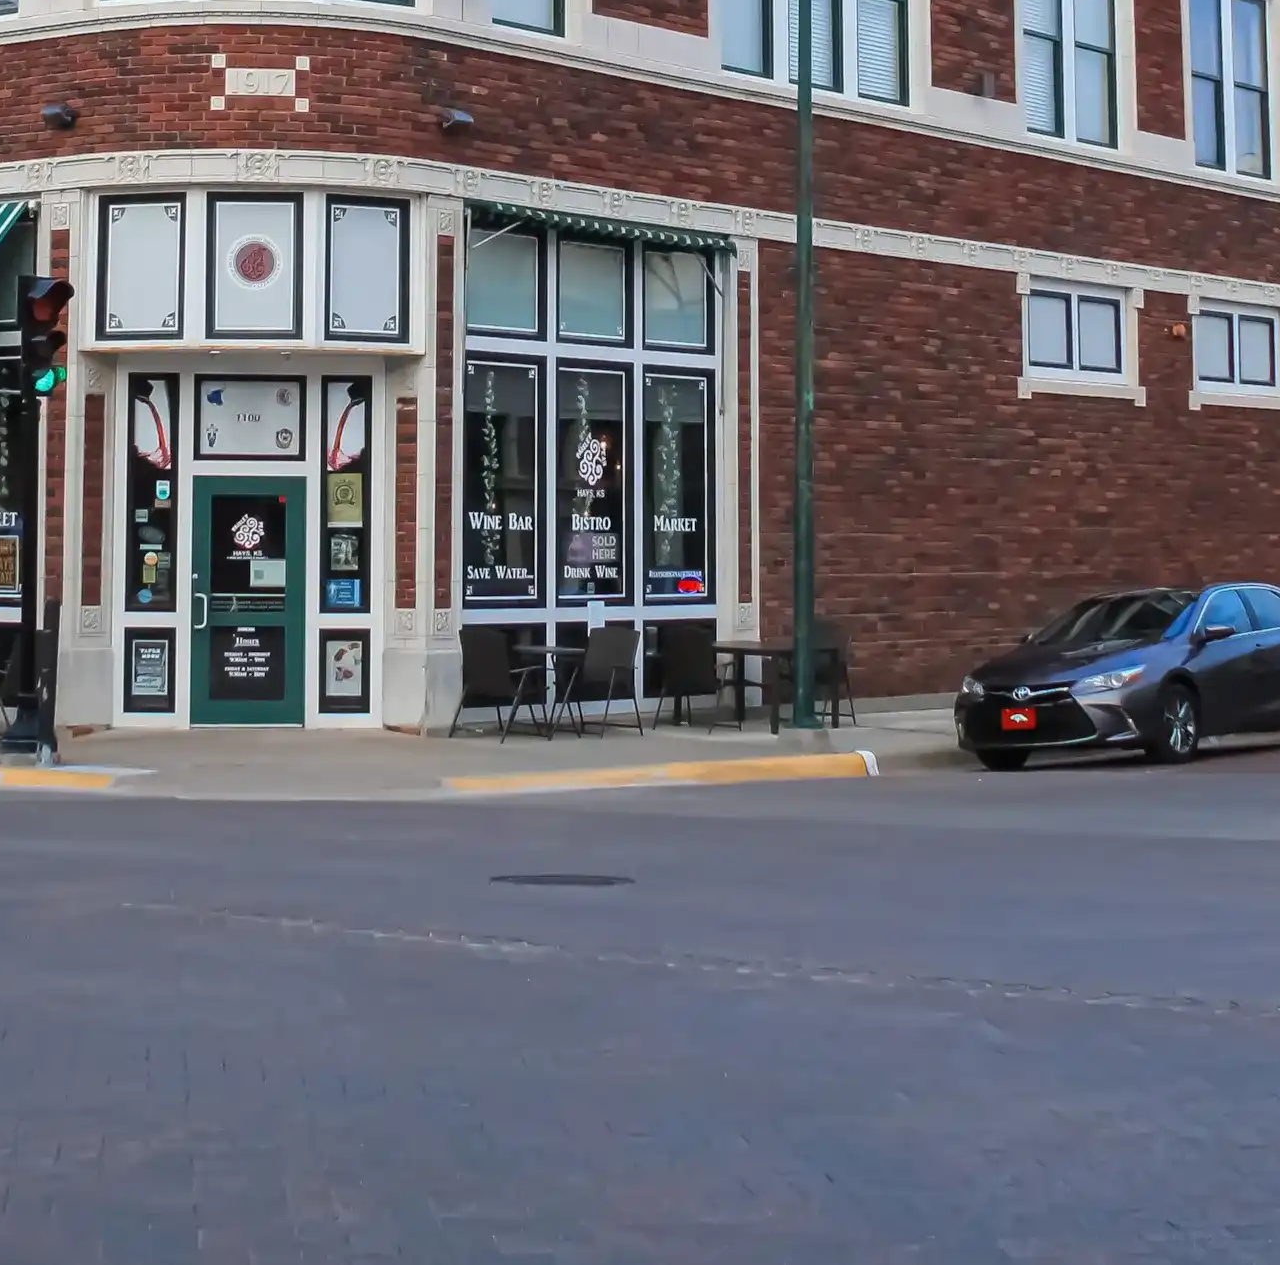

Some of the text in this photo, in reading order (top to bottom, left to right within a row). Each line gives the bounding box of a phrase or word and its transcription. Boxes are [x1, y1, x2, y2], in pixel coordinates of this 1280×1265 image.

[231, 70, 289, 94] 1917
[591, 535, 616, 547] SOLD
[592, 548, 616, 560] HERE
